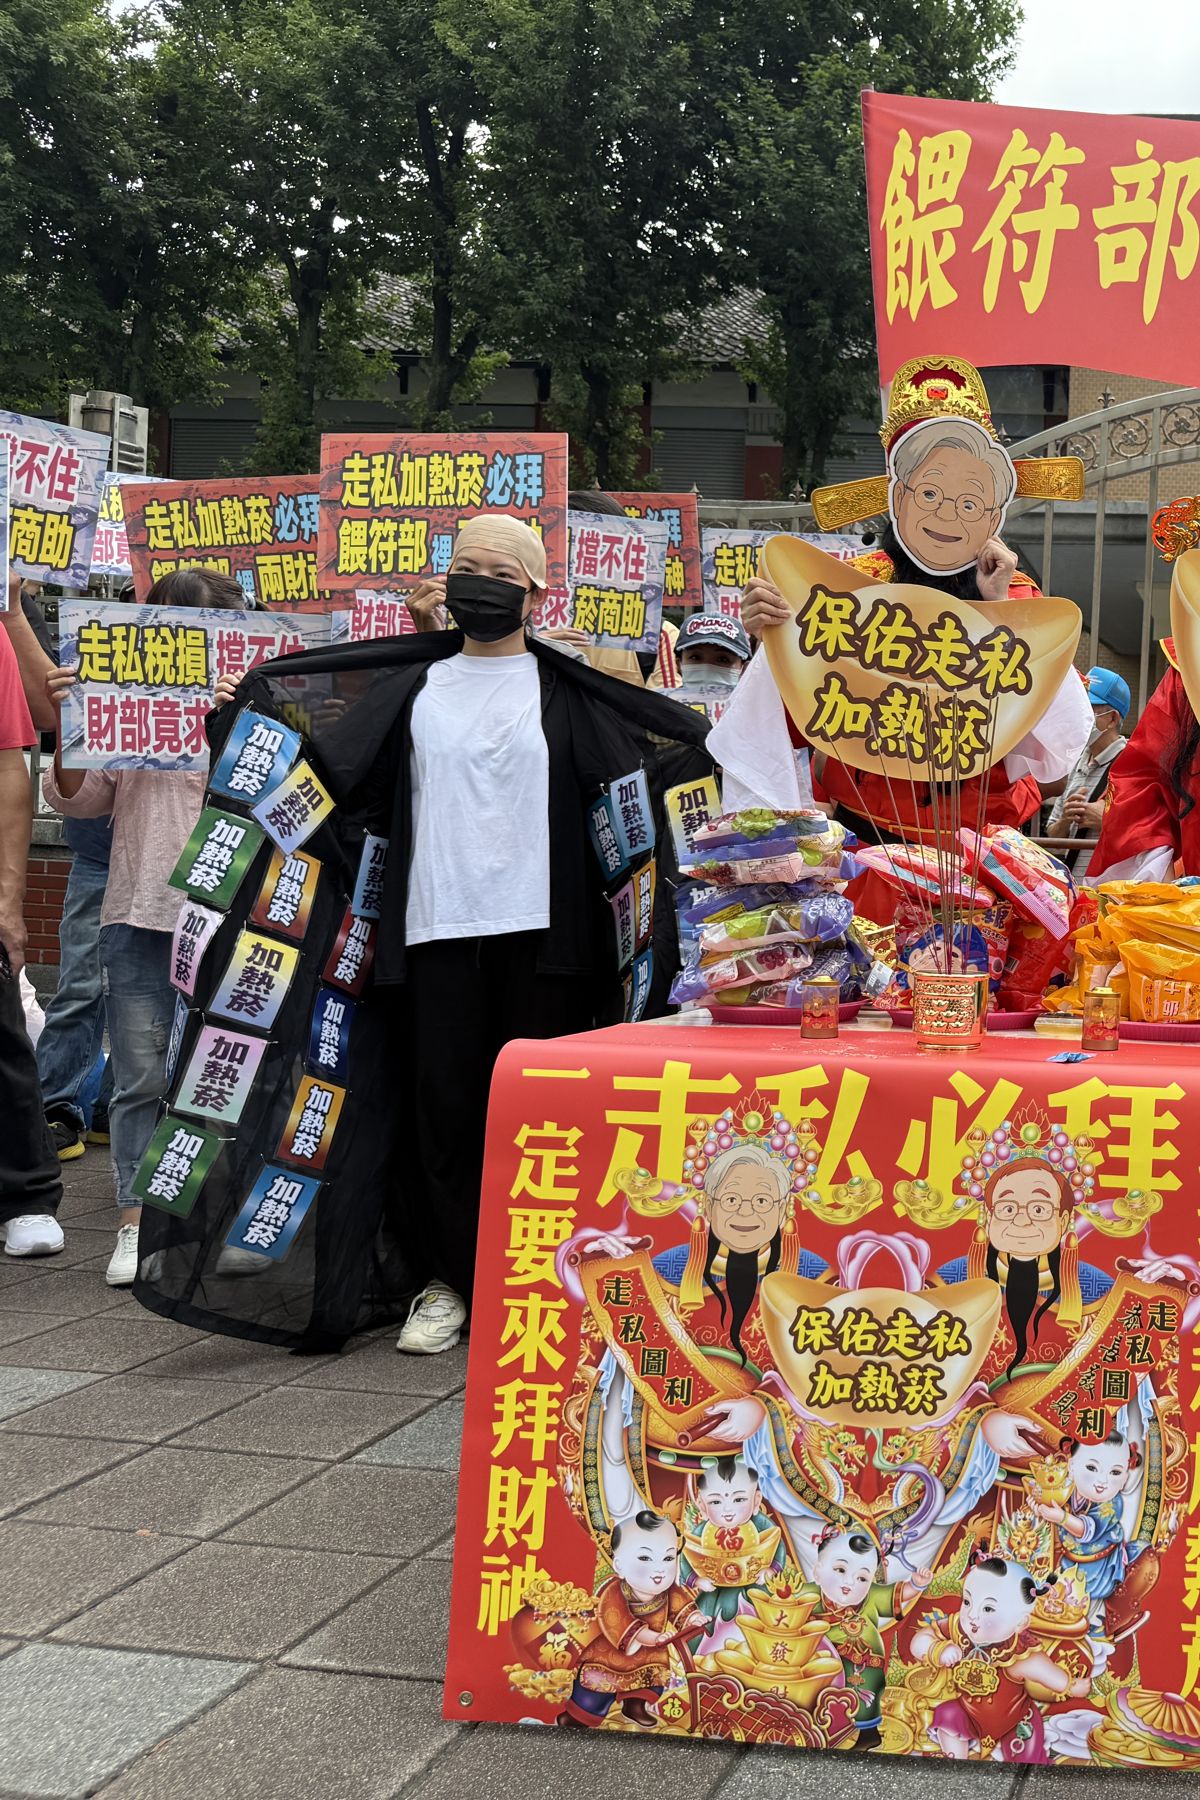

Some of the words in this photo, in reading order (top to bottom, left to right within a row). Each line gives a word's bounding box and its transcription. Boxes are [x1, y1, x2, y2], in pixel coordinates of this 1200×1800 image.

[0, 432, 80, 502] 不住
[341, 452, 544, 508] 走私加熱菸必拜
[9, 507, 75, 570] 商助
[144, 493, 320, 550] 走私加熱菸必拜
[575, 528, 647, 582] 擋不住
[799, 588, 1030, 695] 保佑走私
[88, 697, 209, 753] 財部竟求
[228, 721, 284, 797] 加熱菸
[810, 676, 990, 771] 加熱菸
[265, 775, 326, 840] 加熱菸
[591, 804, 622, 874] 加熱菸
[617, 778, 648, 849] 加熱菸
[186, 818, 247, 893] 加熱菸
[267, 854, 310, 928] 加熱菸
[175, 909, 207, 986] 加熱菸
[225, 942, 284, 1018] 加熱菸
[334, 916, 372, 985] 加熱菸
[318, 997, 346, 1069] 加熱菸
[190, 1035, 250, 1113] 加熱菸
[290, 1085, 333, 1160] 加熱菸
[596, 1060, 1187, 1221] 走私必拜
[147, 1127, 205, 1203] 加熱菸
[242, 1175, 305, 1250] 加熱菸
[476, 1066, 591, 1637] 一定要來拜財神
[603, 1275, 693, 1407] 走私圖利
[793, 1306, 970, 1361] 保佑走私
[1076, 1301, 1178, 1438] 走私圖利
[808, 1361, 945, 1414] 加熱菸
[715, 1526, 745, 1551] 福
[662, 1697, 684, 1719] 福
